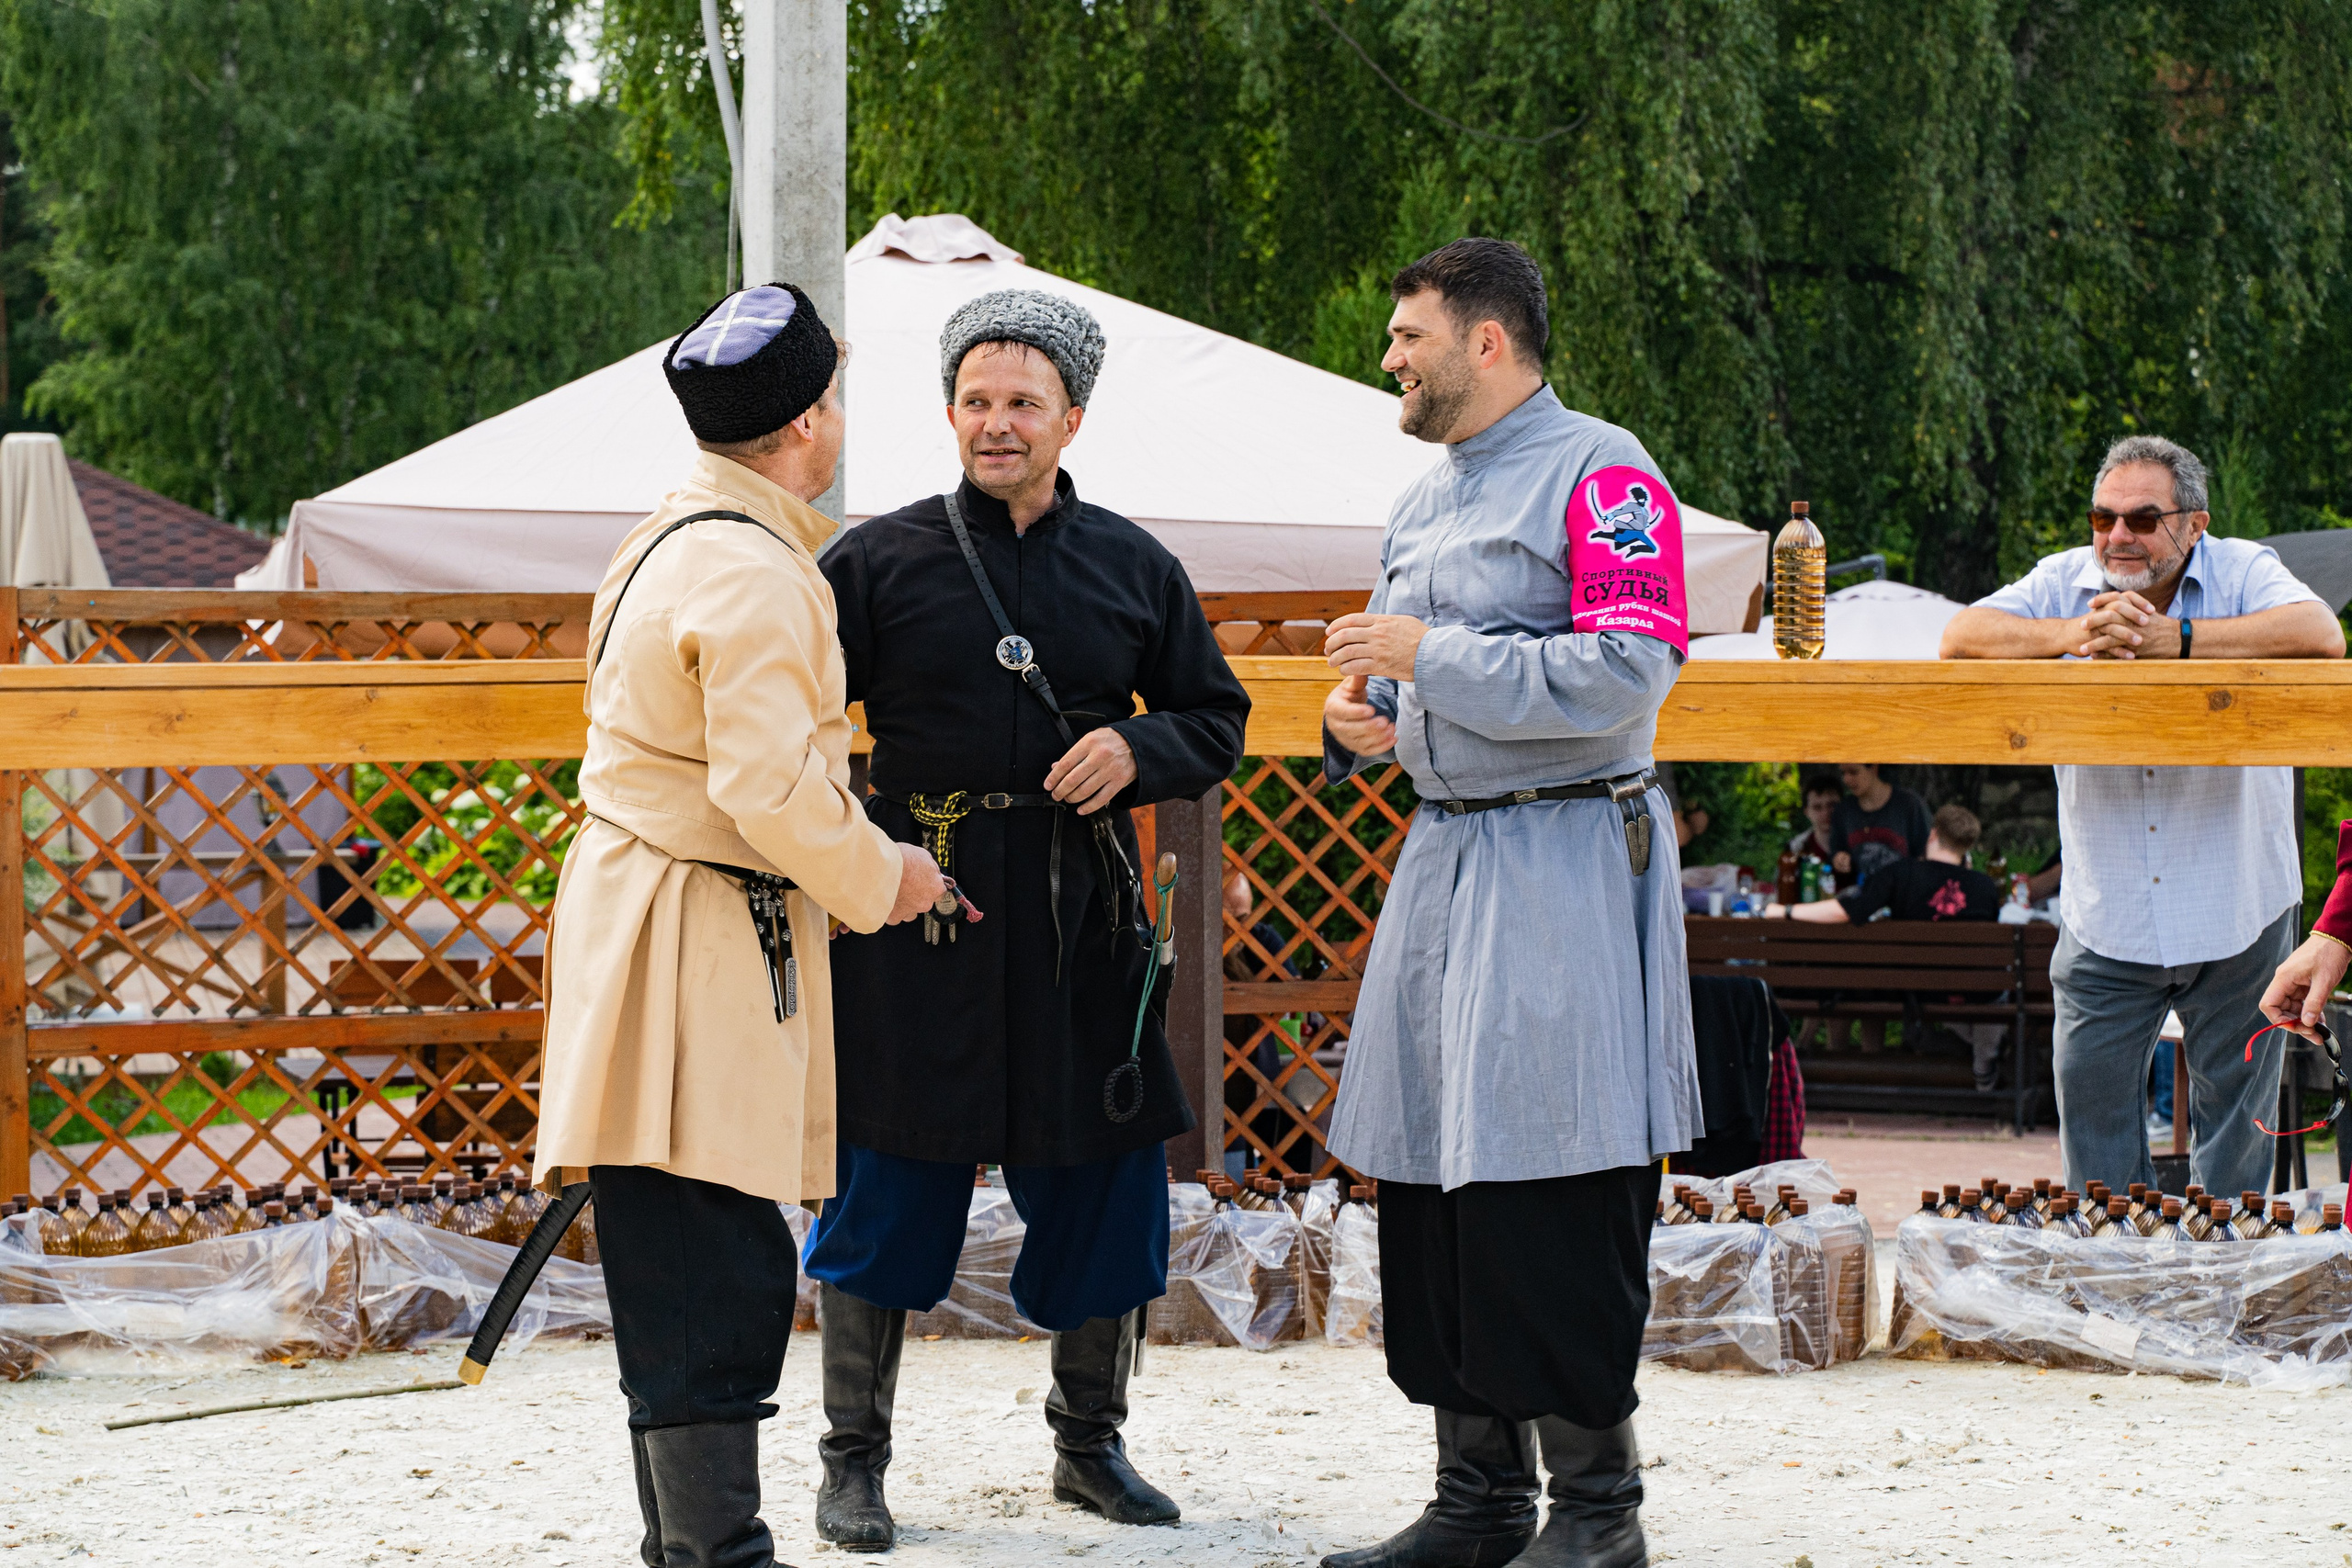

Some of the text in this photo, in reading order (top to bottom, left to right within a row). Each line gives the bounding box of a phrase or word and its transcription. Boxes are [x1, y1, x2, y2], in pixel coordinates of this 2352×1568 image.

[1581, 568, 1668, 586] Спортивный
[1584, 580, 1668, 607] СУДЬЯ
[1618, 601, 1649, 613] рубки
